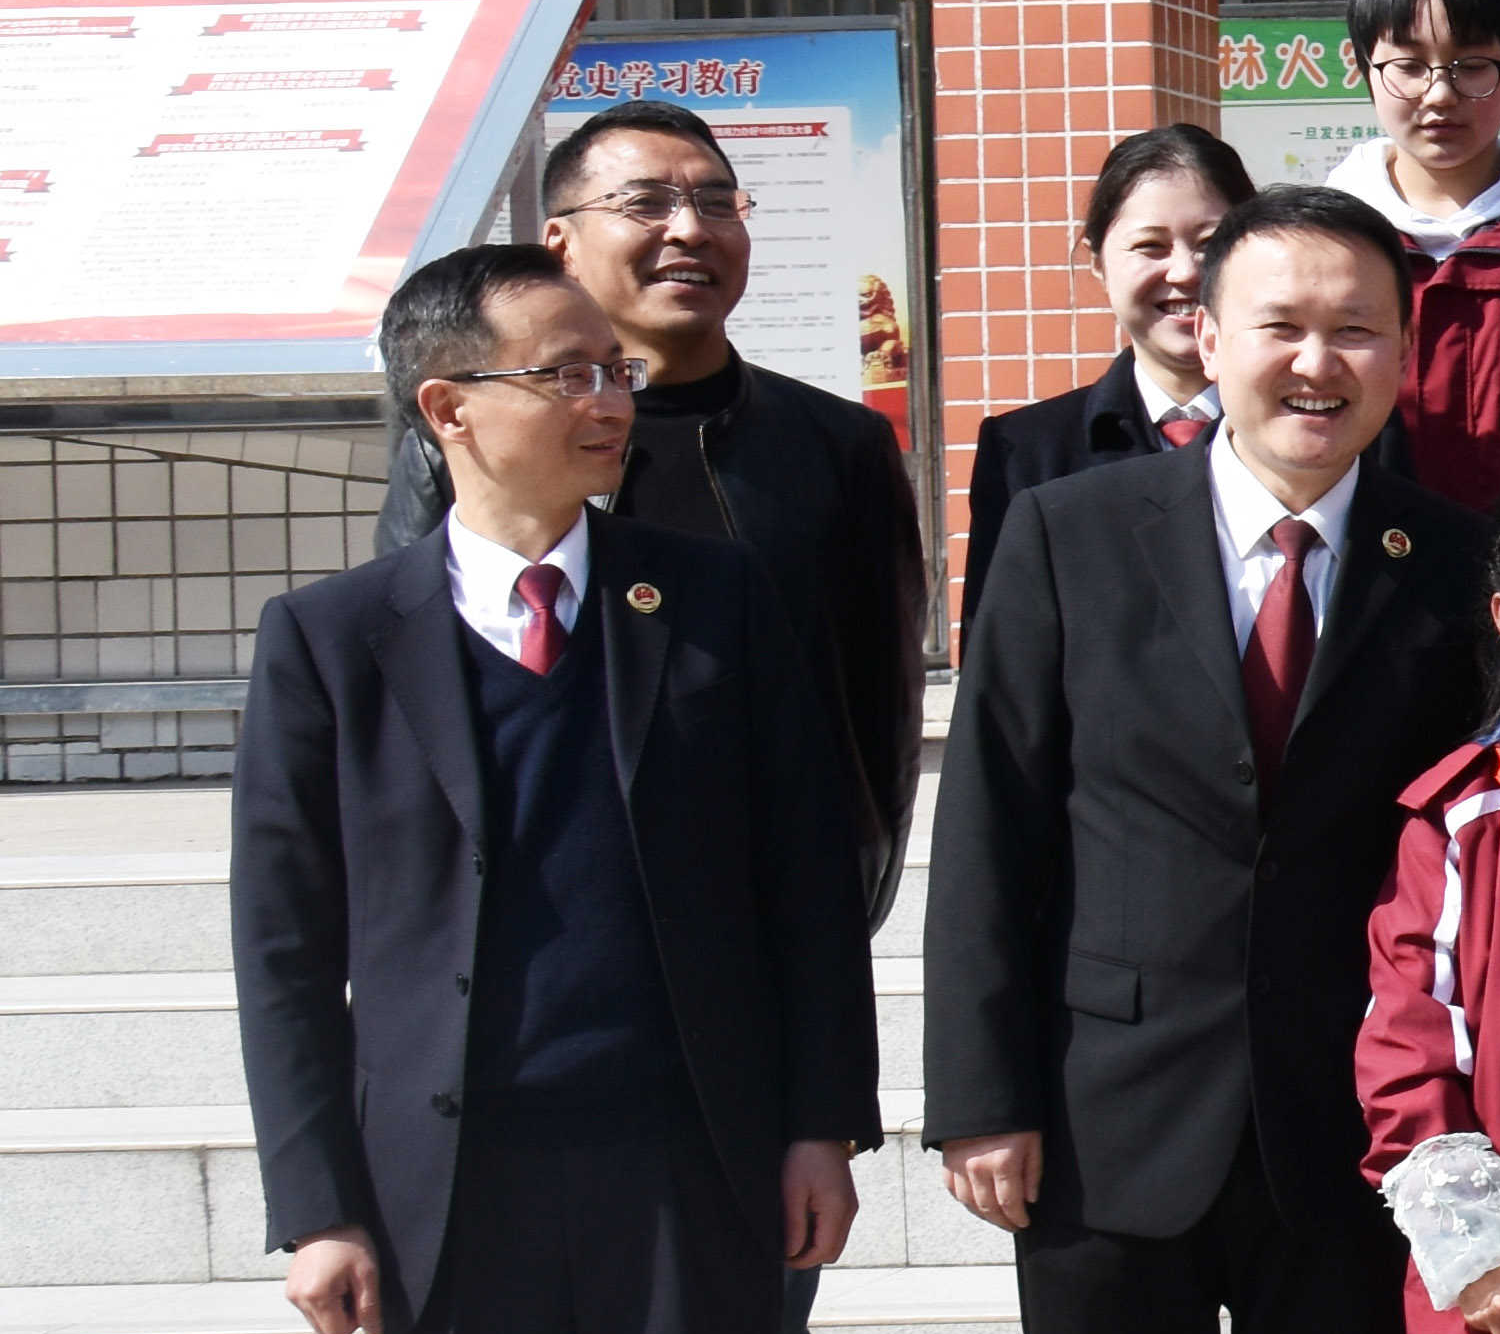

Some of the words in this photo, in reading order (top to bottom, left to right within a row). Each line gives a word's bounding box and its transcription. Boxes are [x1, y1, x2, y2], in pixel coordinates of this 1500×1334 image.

[552, 58, 764, 99] 党史学习教育
[1290, 126, 1387, 140] 一旦发生森林
